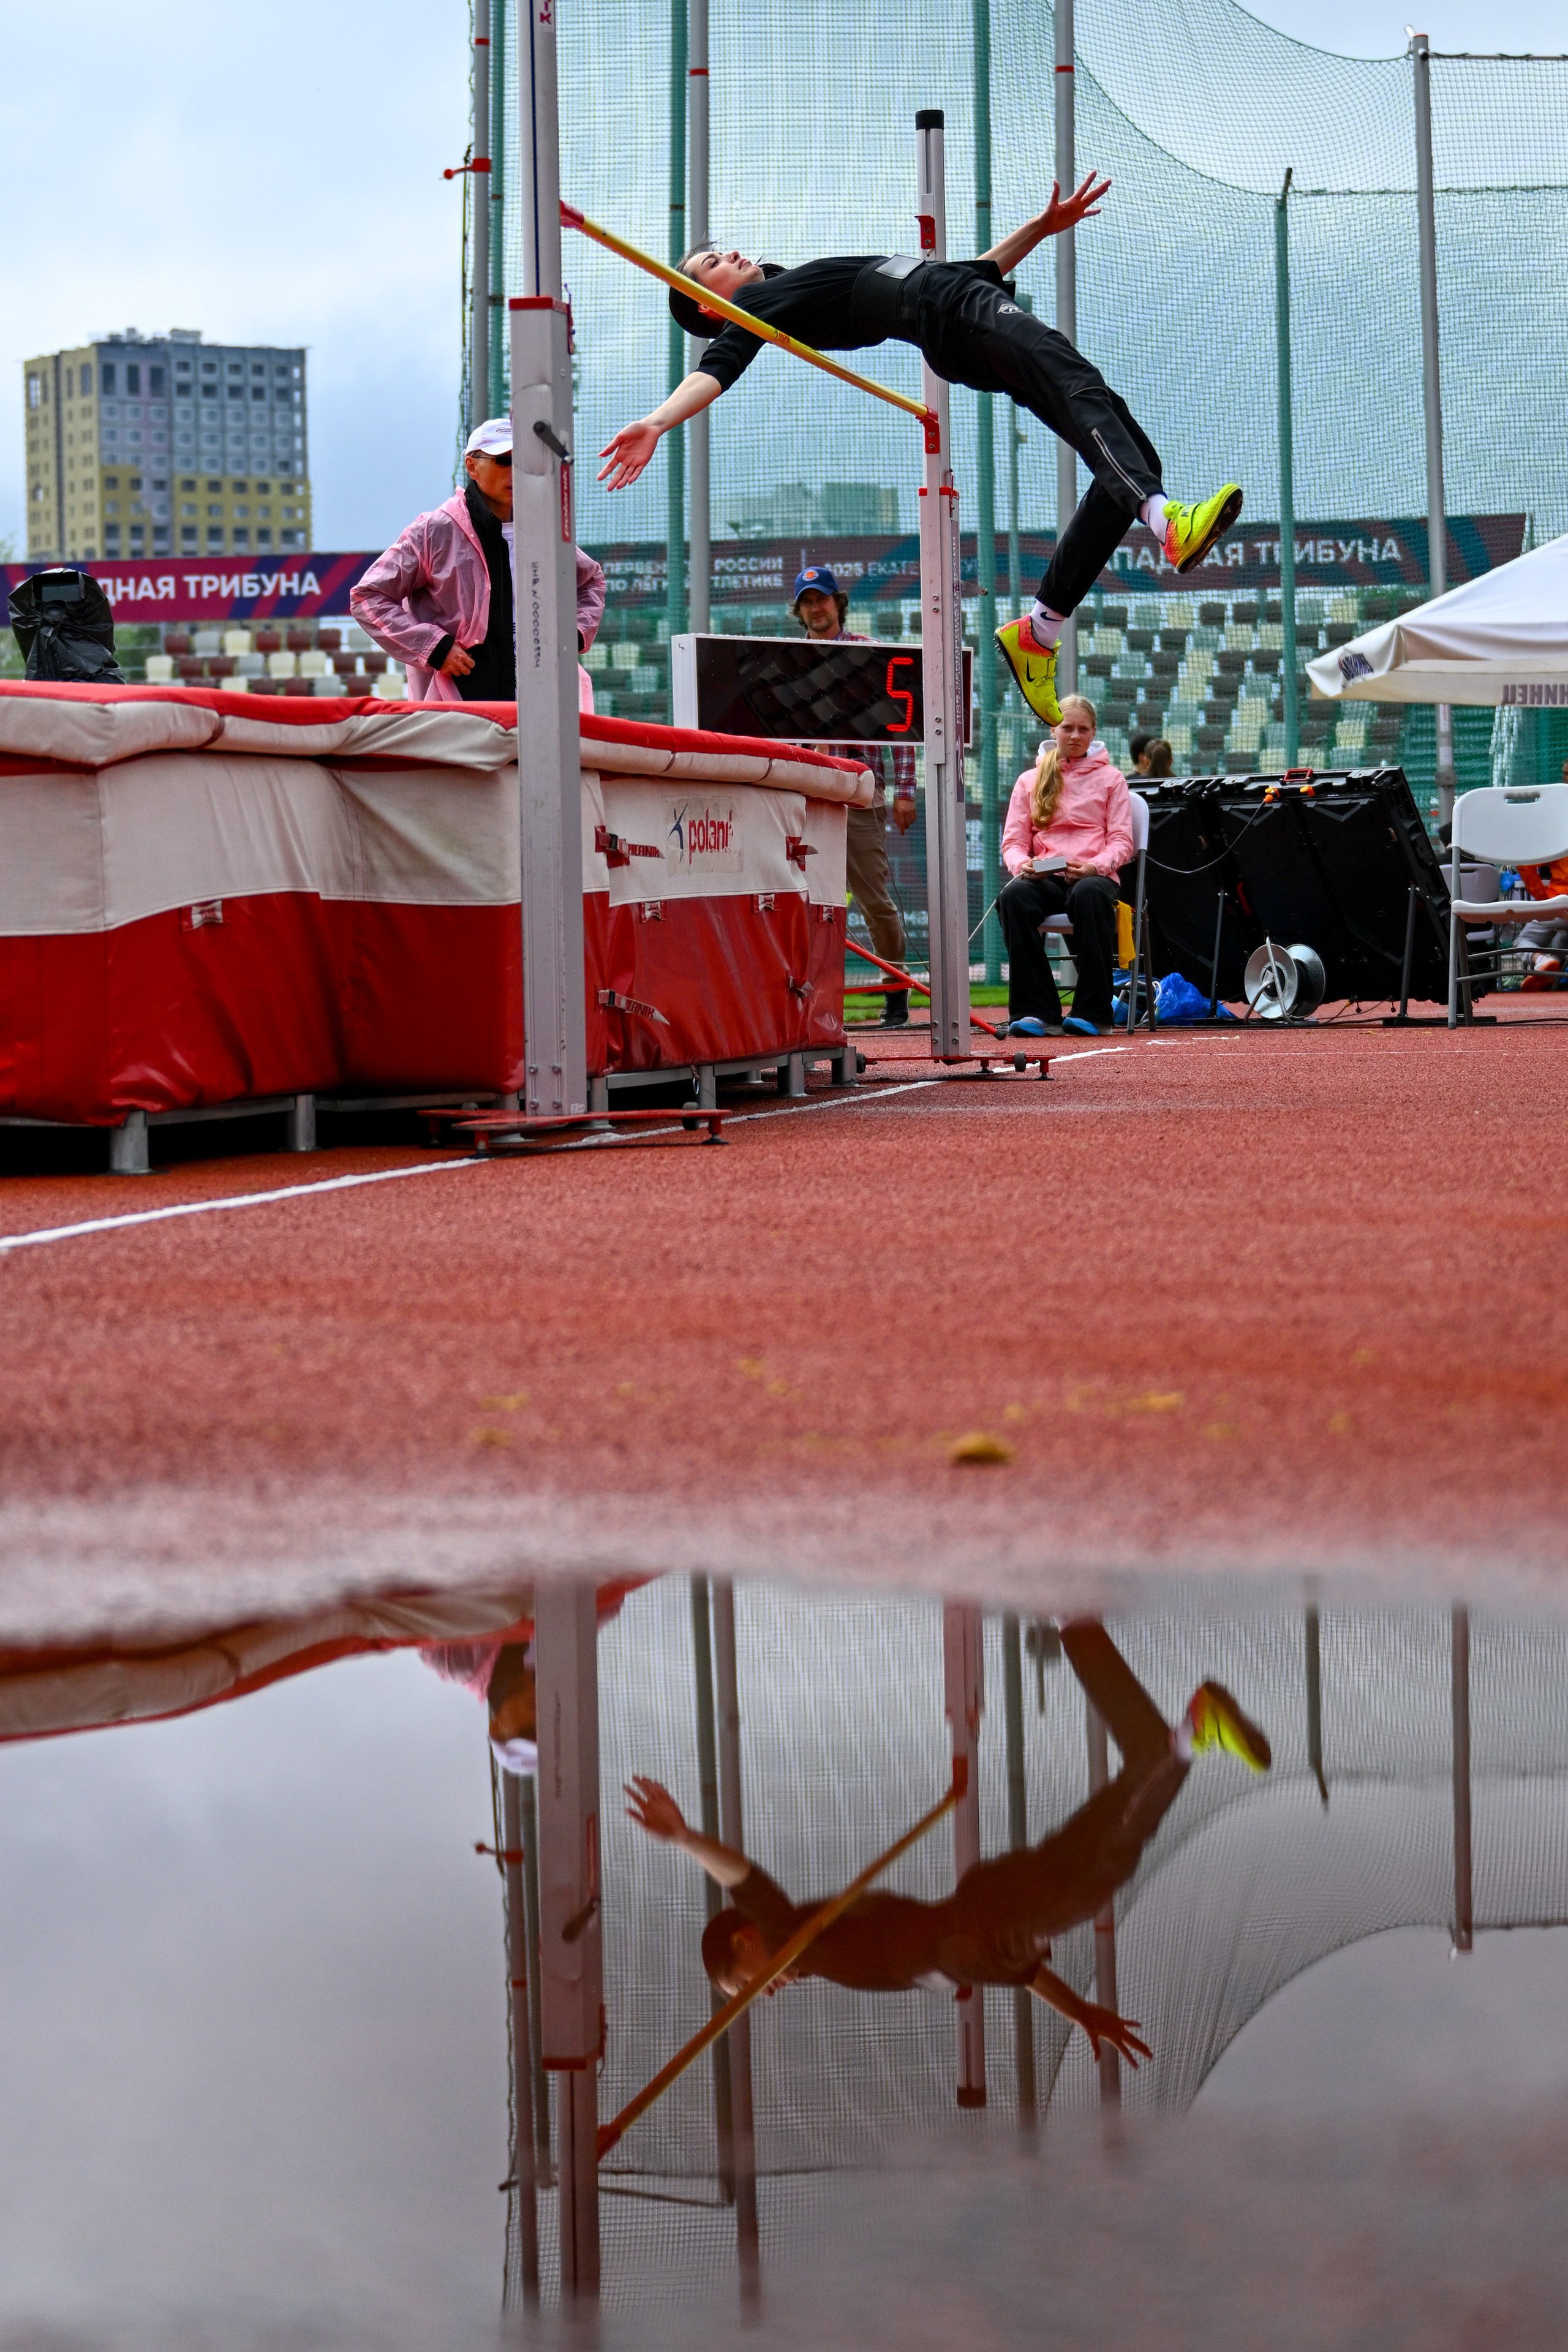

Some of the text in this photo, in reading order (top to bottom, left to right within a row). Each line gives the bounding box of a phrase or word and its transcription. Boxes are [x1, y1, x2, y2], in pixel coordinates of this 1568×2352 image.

[714, 556, 783, 572] РОССИИ
[183, 572, 322, 599] ТРИБУНА
[710, 573, 783, 589] ТЛЕТИКЕ
[886, 657, 914, 733] 5
